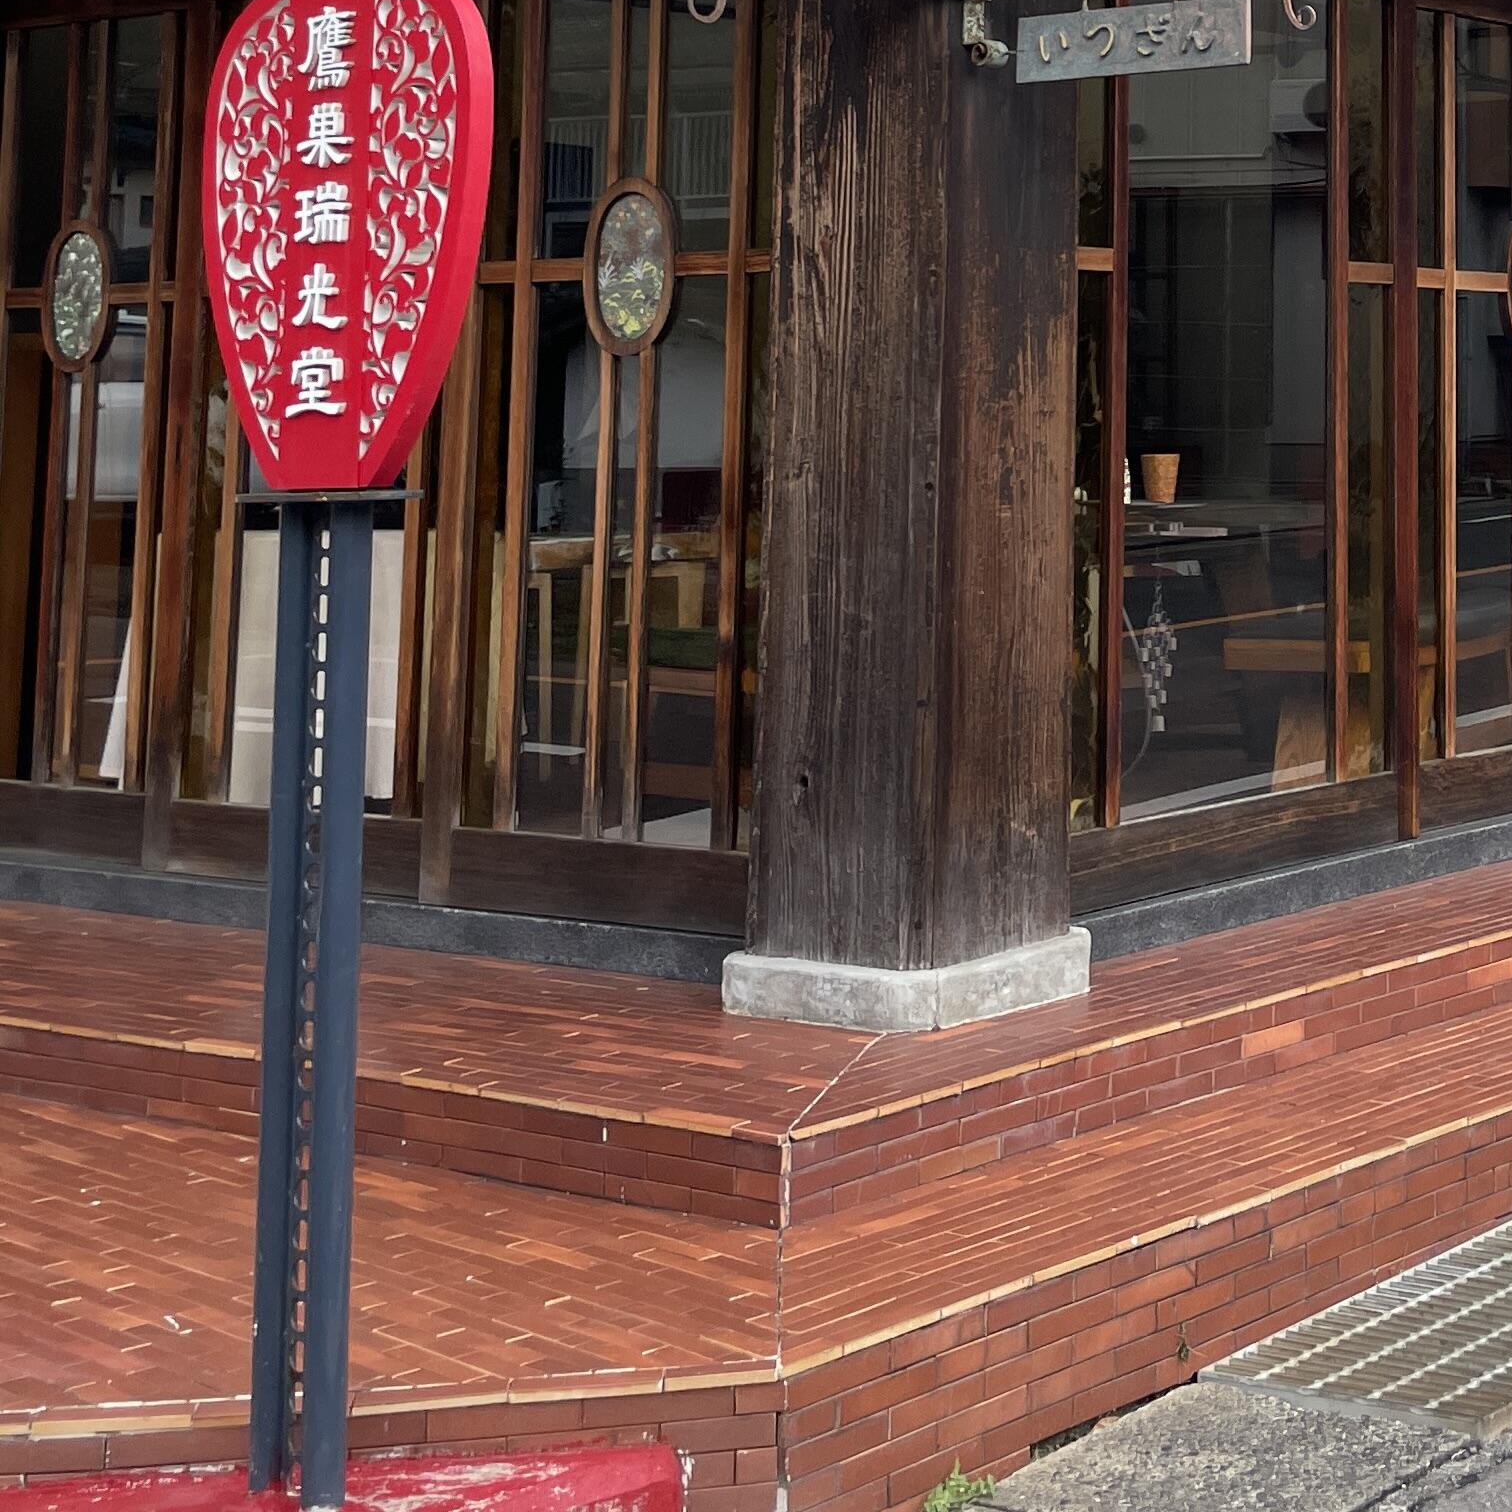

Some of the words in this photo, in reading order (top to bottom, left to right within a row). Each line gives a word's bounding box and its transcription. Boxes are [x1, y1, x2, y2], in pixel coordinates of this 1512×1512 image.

[285, 6, 357, 419] 鷹巣瑞光堂
